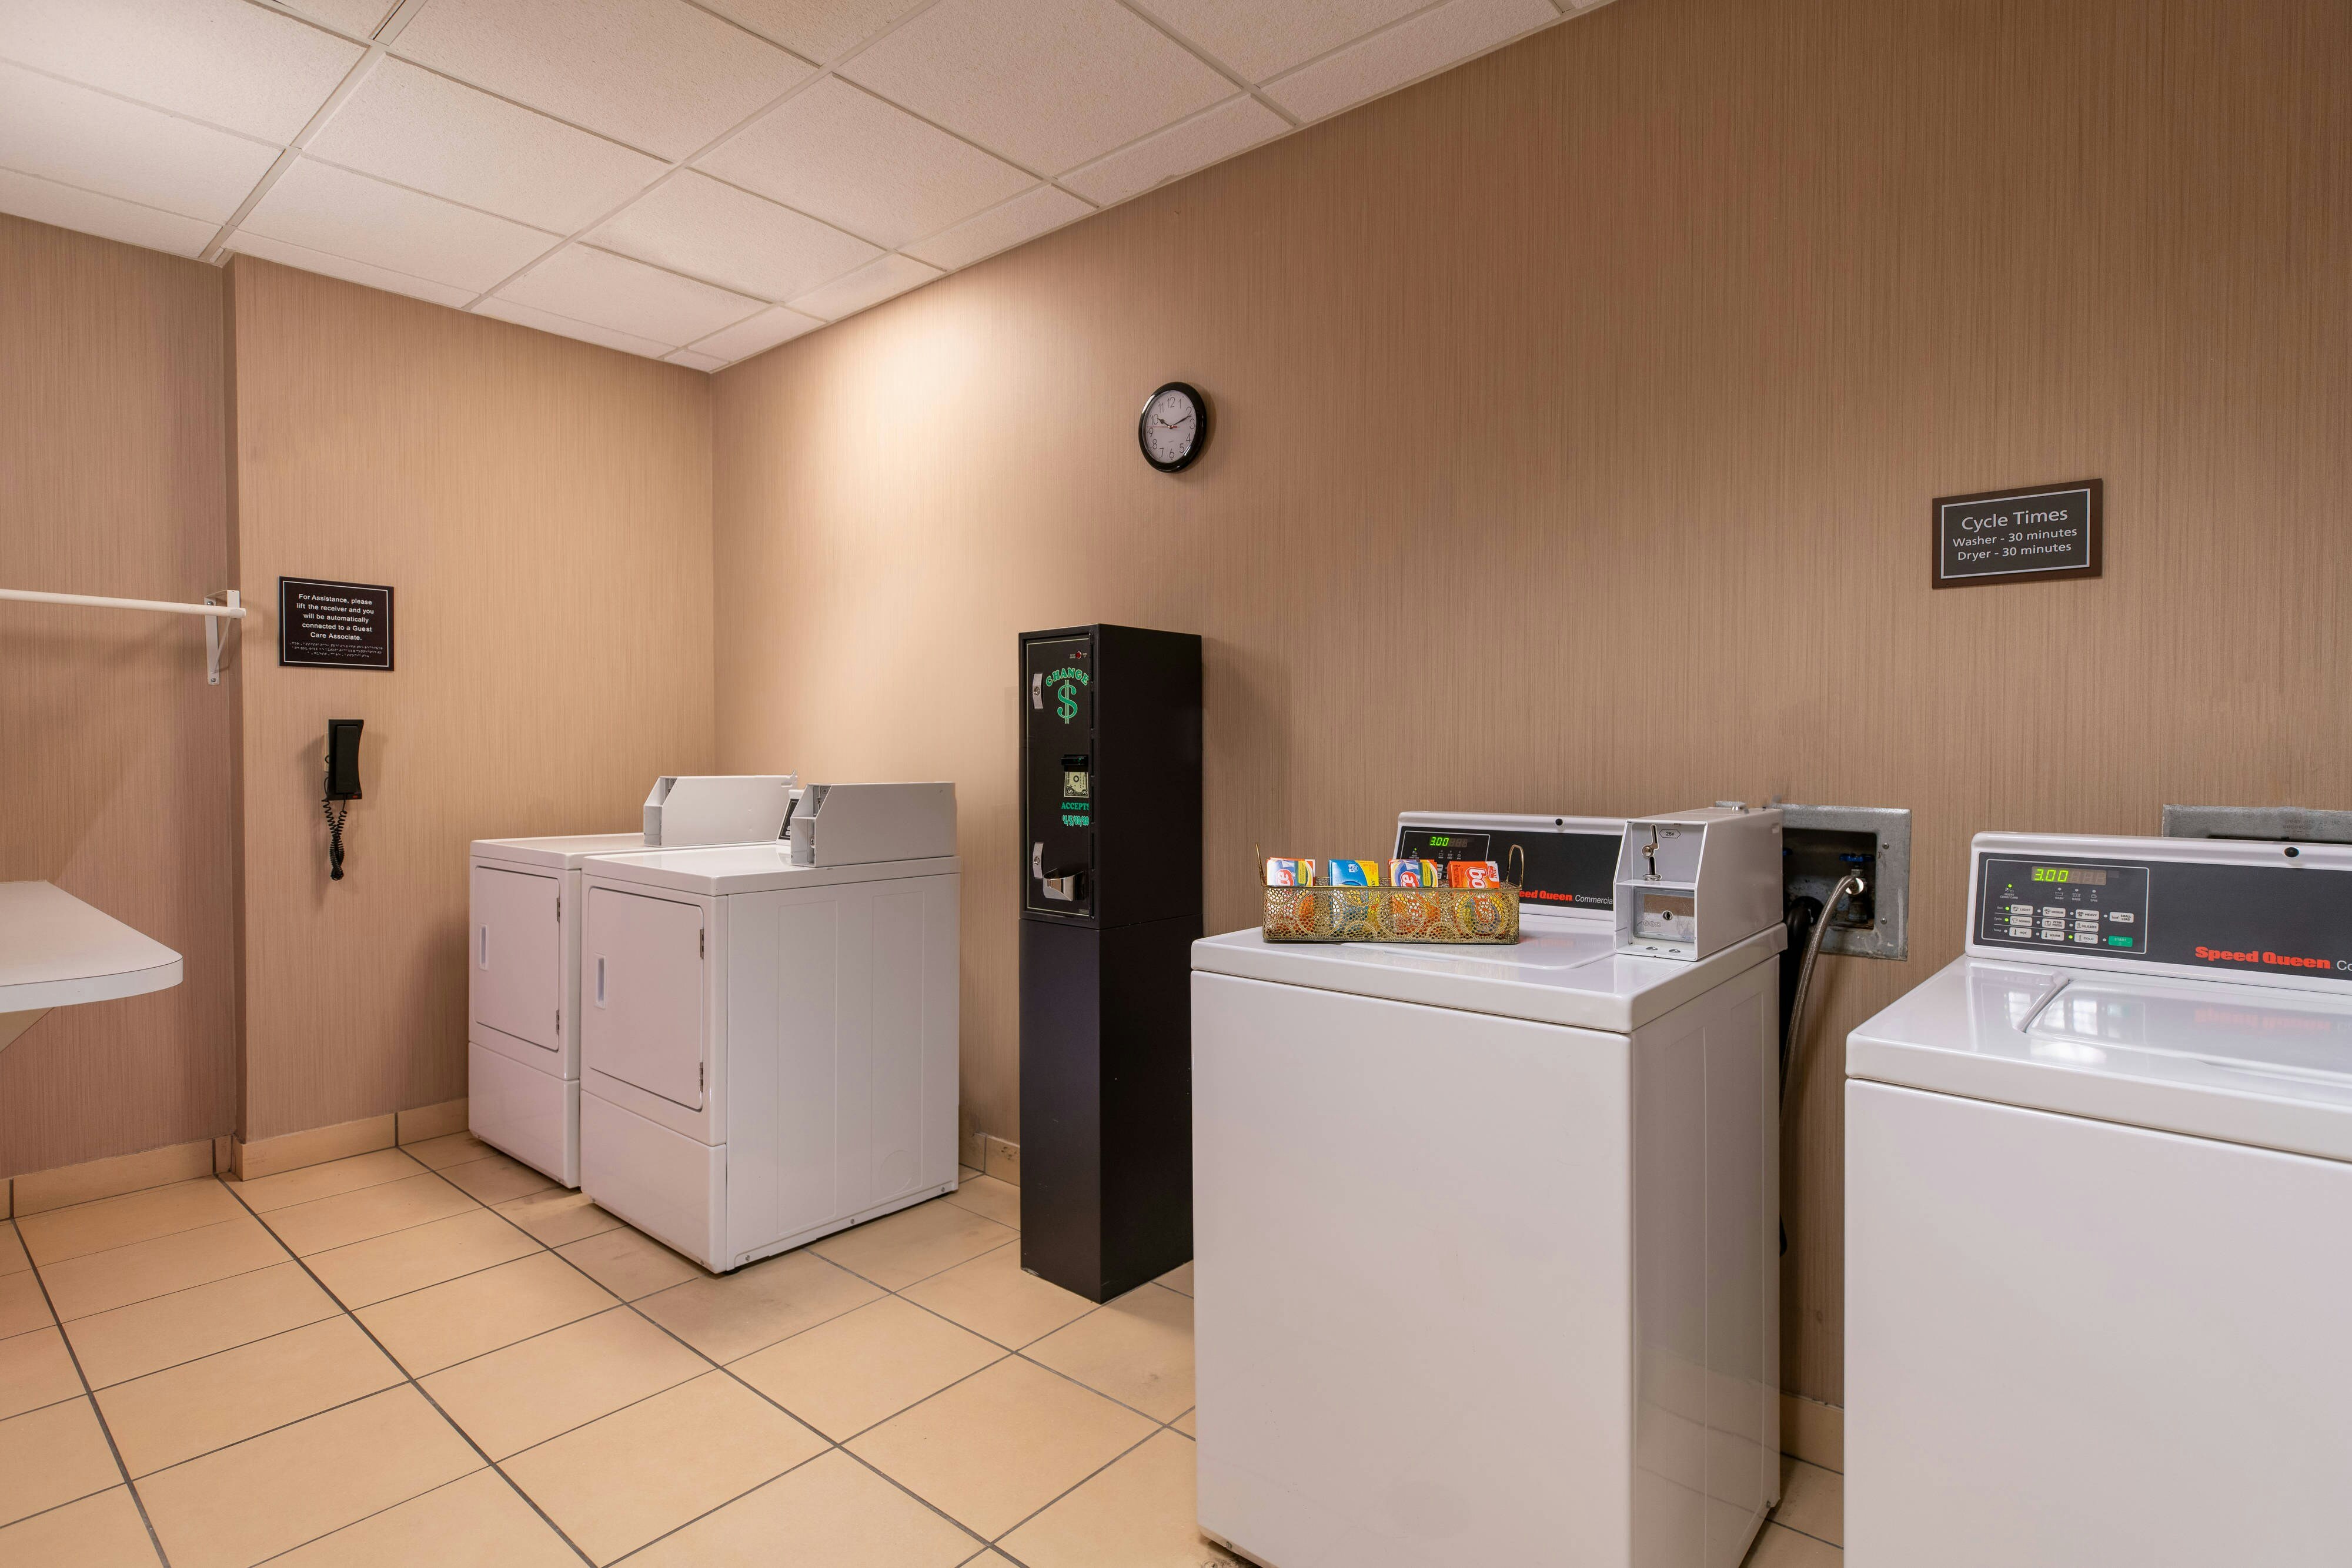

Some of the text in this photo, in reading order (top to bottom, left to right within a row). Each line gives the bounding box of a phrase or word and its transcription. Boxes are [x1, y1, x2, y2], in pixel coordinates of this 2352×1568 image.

[1158, 402, 1164, 413] 11
[1167, 396, 1175, 409] 12
[1178, 399, 1181, 409] 1
[1190, 418, 1195, 430] 3
[1148, 427, 1154, 437] 9
[1185, 433, 1191, 443] 4
[1152, 439, 1157, 450] 8
[1179, 443, 1185, 453] 5
[1160, 447, 1164, 457] 7
[1169, 449, 1175, 459] 6
[1962, 509, 2068, 533] Cycle Times
[1953, 536, 1997, 547] Washer
[2009, 532, 2023, 542] 30
[2027, 528, 2077, 541] minutes
[1958, 550, 1991, 561] Dryer
[2003, 547, 2017, 557] 30
[2021, 543, 2072, 556] minutes
[312, 594, 349, 604] Assistance,
[326, 615, 369, 624] automatically
[328, 633, 362, 641] Associate.
[1045, 667, 1089, 687] CHANGE
[1057, 680, 1078, 724] $
[1430, 837, 1449, 846] 3.00
[2034, 868, 2069, 882] 3.00
[1519, 890, 1613, 904] eed Queen Commercia
[2195, 946, 2259, 962] Speed
[2262, 951, 2331, 969] Queen
